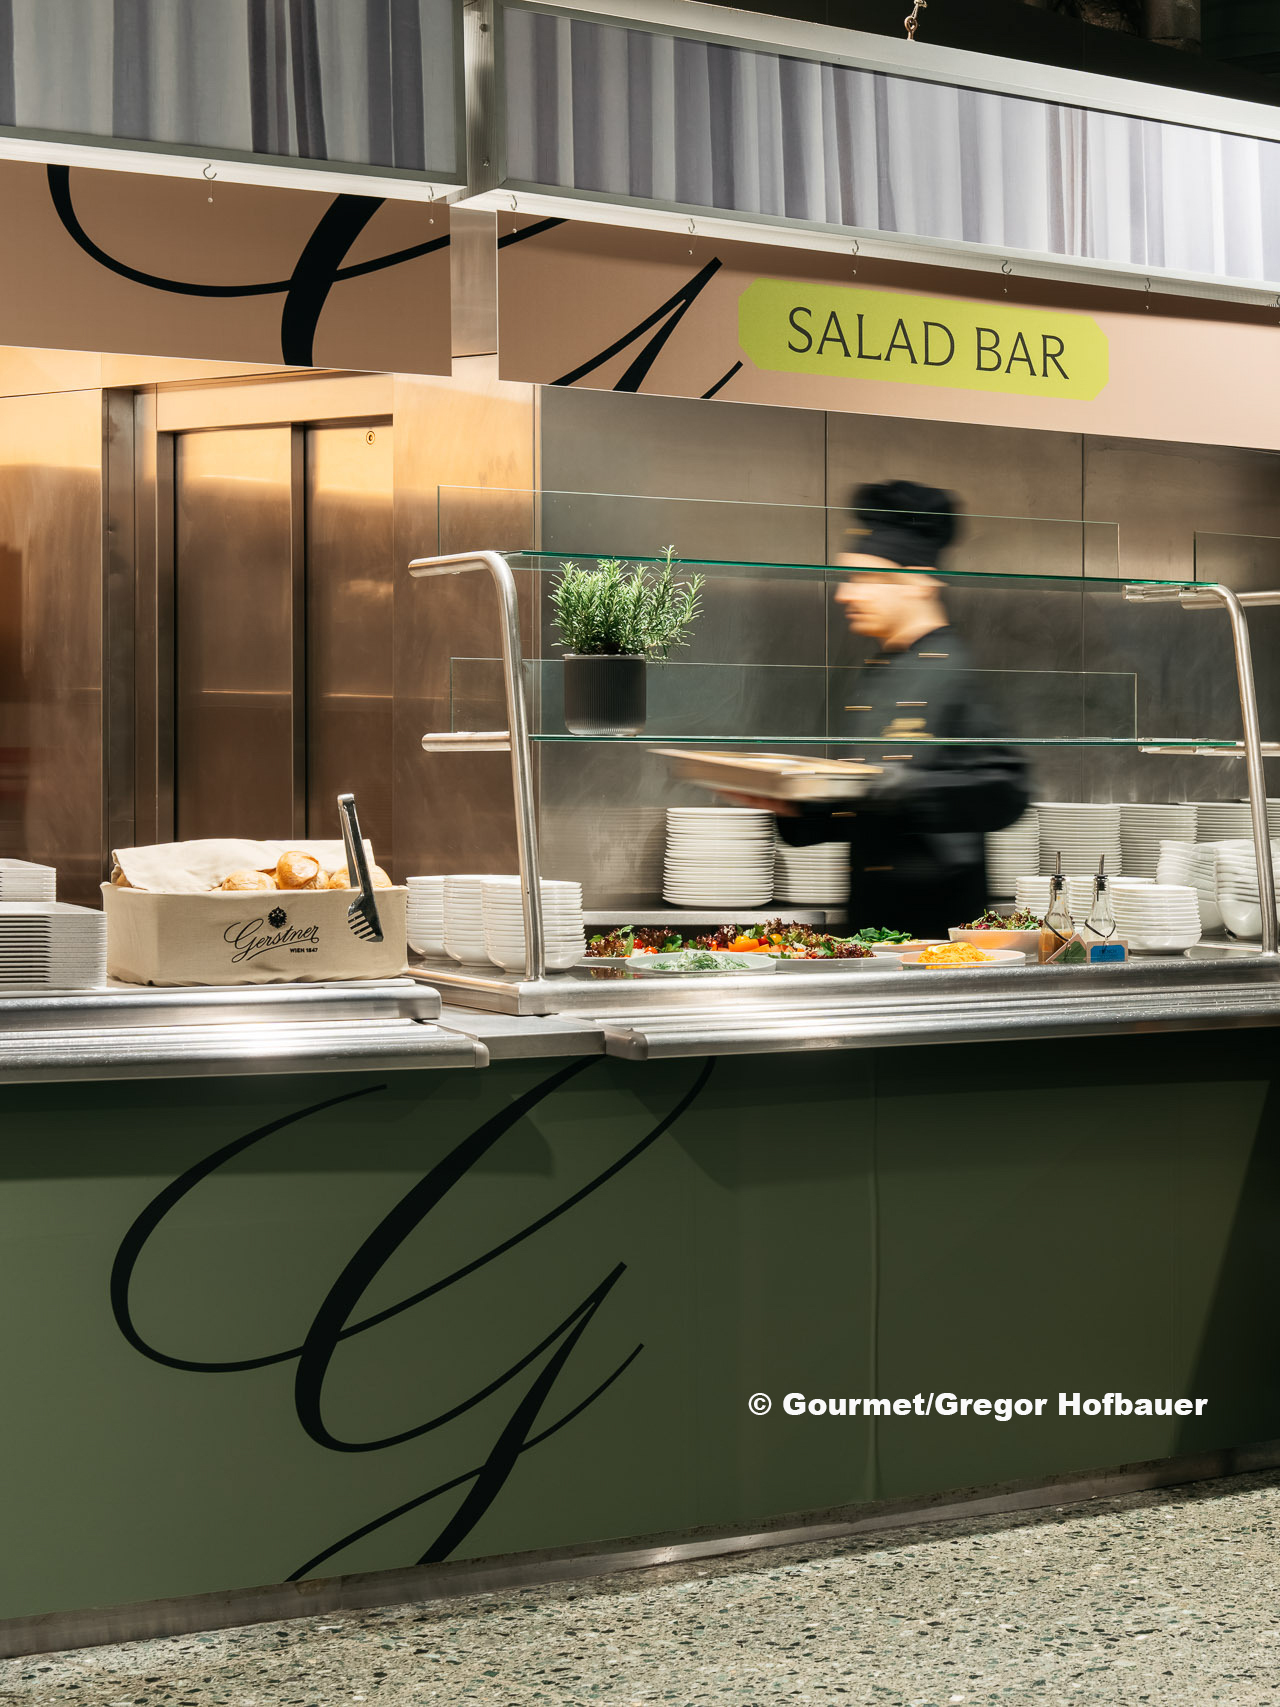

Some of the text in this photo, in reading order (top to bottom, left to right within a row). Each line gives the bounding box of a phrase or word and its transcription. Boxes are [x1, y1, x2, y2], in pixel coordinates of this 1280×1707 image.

[787, 306, 1070, 380] SALAD BAR
[223, 918, 320, 963] Gerstner
